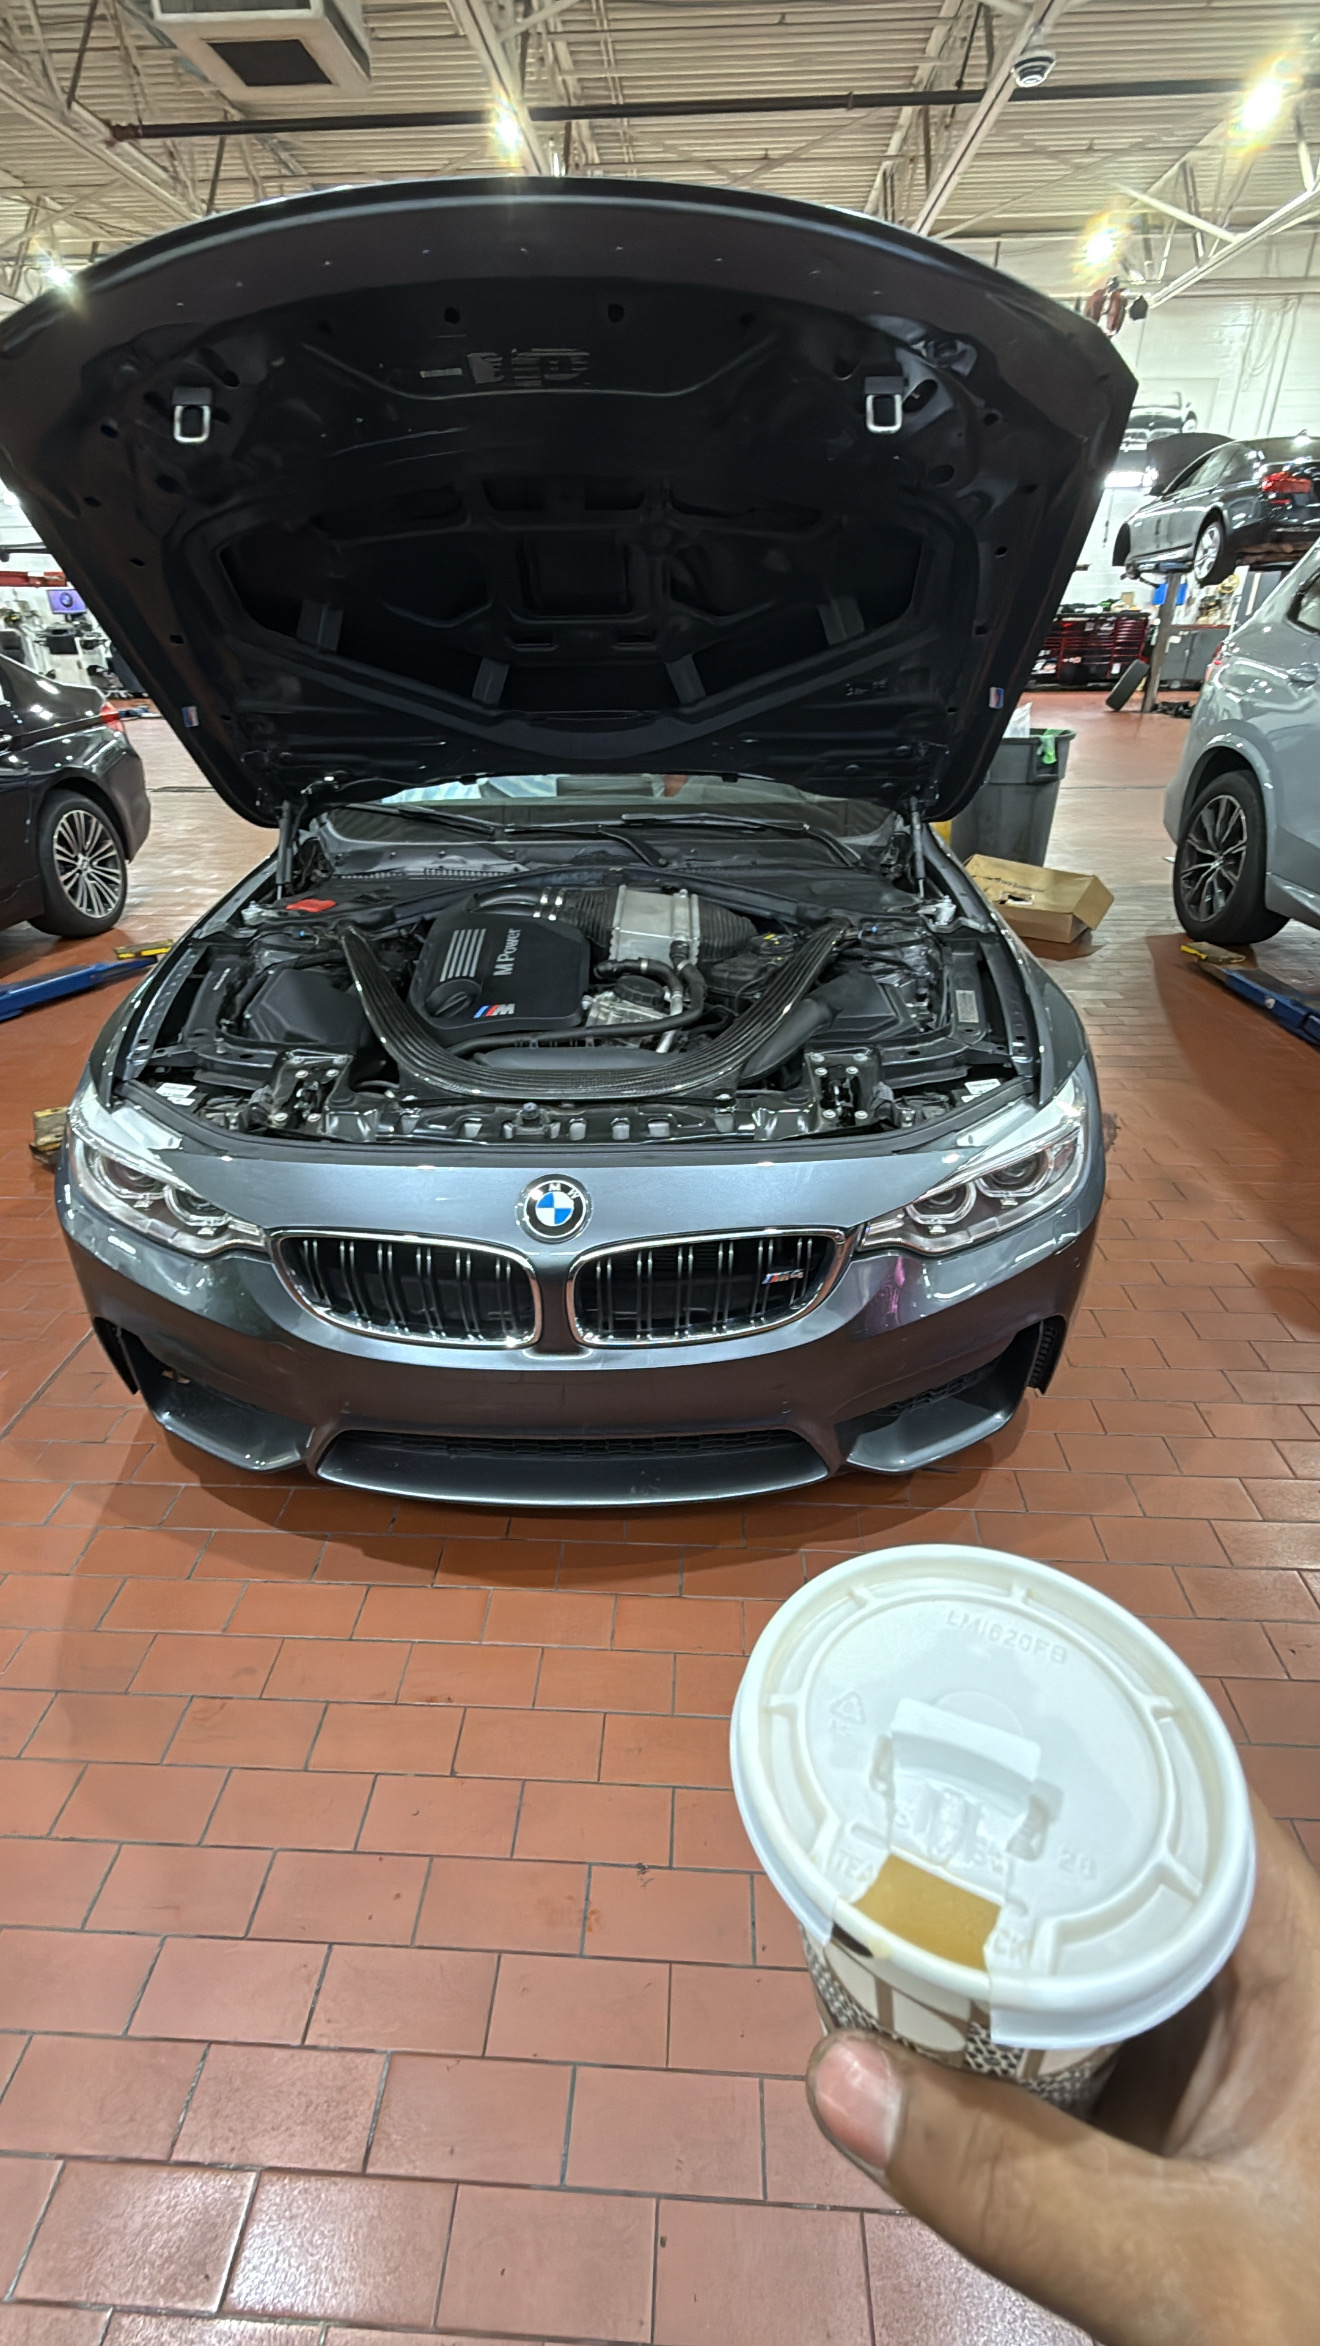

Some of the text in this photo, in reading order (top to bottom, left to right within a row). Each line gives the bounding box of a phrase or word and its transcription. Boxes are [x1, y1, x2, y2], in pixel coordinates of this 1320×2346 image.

[493, 928, 521, 976] M Power
[486, 1003, 516, 1017] M
